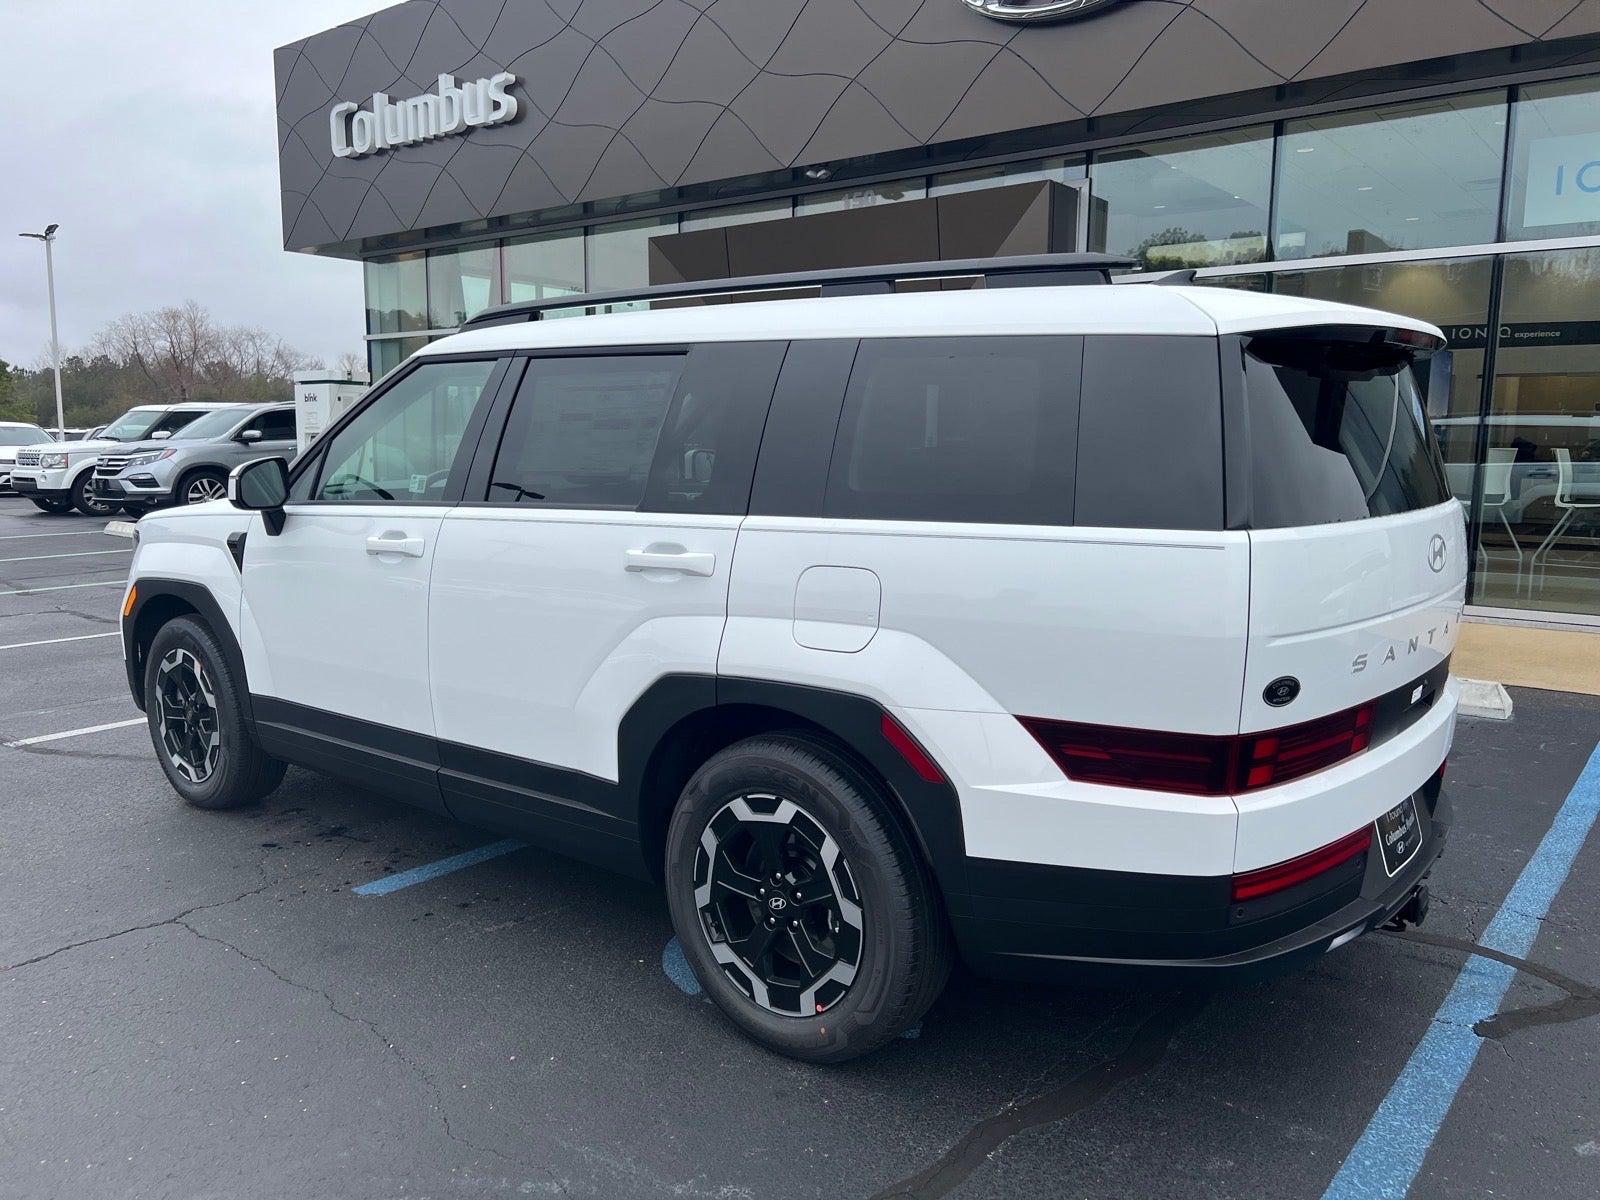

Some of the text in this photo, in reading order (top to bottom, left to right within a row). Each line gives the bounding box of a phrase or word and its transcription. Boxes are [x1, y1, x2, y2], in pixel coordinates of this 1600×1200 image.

[330, 72, 517, 157] Columbus
[1451, 326, 1561, 339] IONQ experience
[1351, 620, 1450, 674] SANTA
